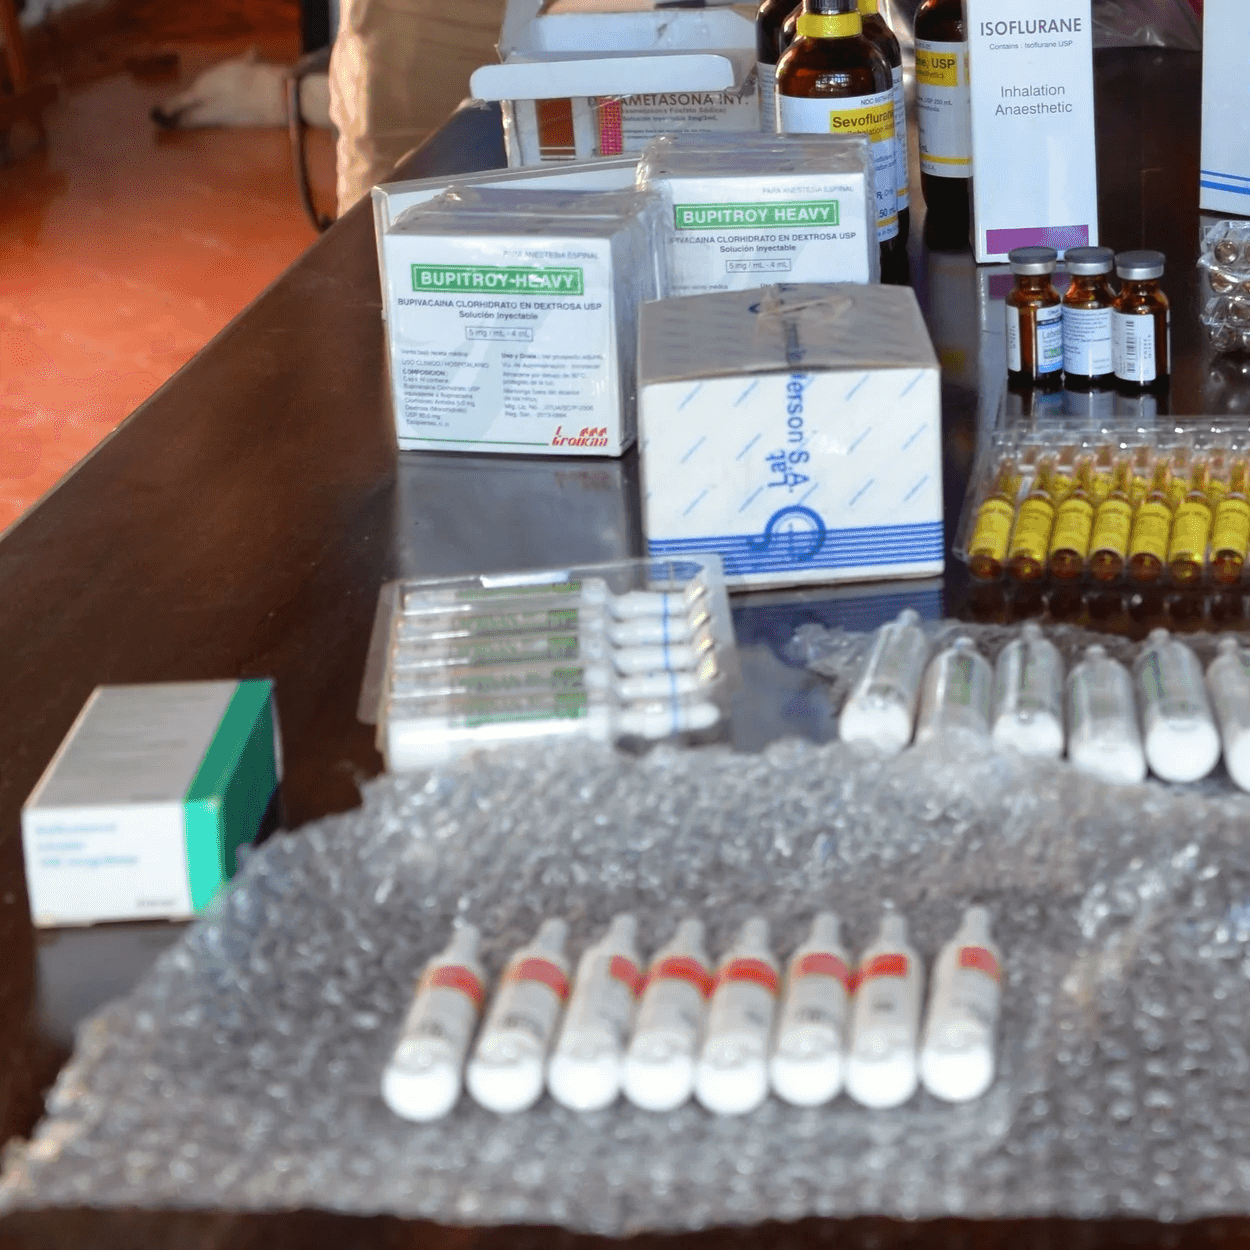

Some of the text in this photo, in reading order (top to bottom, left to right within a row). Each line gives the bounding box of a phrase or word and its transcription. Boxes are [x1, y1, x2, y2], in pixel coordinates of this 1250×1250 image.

[980, 17, 1082, 37] ISOFLURANE
[1058, 39, 1074, 48] USP
[931, 58, 956, 70] USP
[1000, 83, 1066, 99] Inhalation
[995, 101, 1073, 116] Anaesthetic
[683, 206, 831, 225] BUPITROY HEAVY
[716, 234, 777, 243] CLORHIDRATO
[778, 233, 791, 242] EN
[791, 232, 838, 242] DEXTROSA
[839, 231, 857, 240] USP
[719, 243, 797, 254] Solución Inyectable
[420, 270, 575, 289] BUPITROY HEAVY
[398, 297, 602, 311] BUPIVACAINA CLORHIDRATO EN DEXTROSA USP
[459, 310, 539, 321] Solución Inyectable
